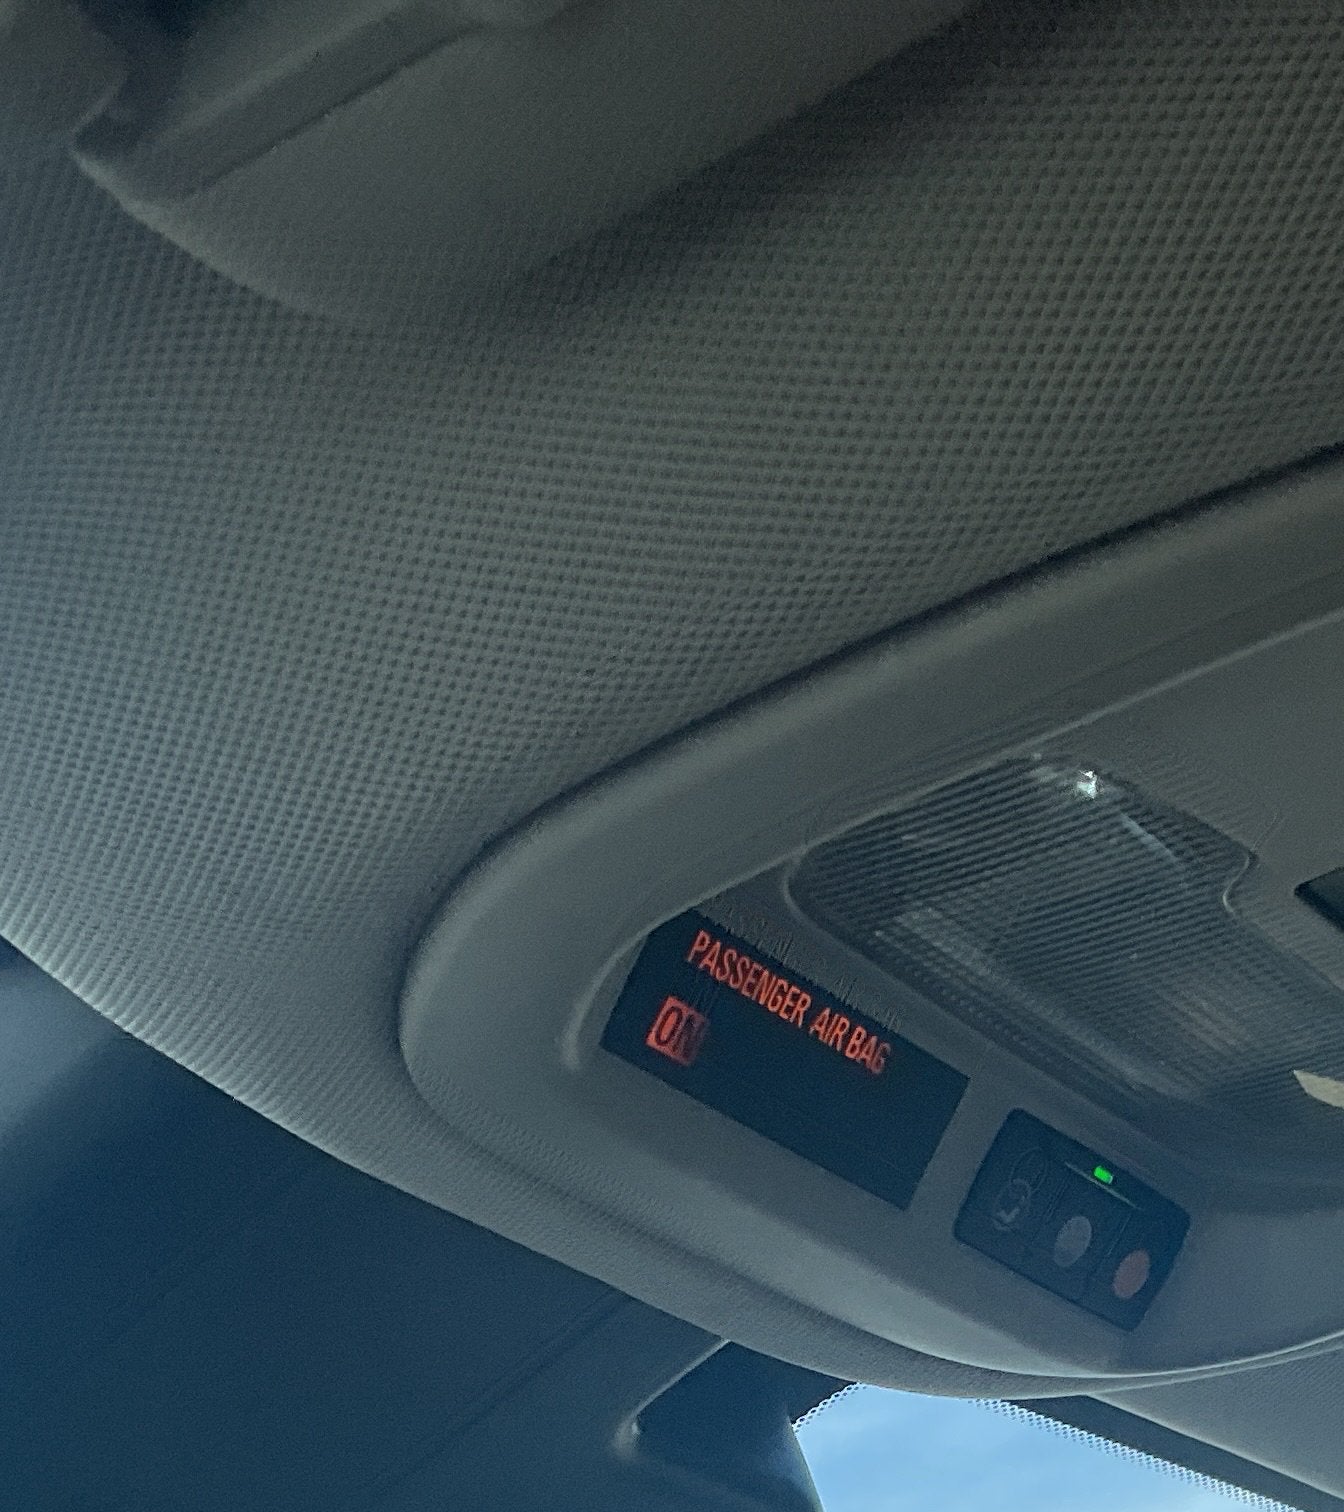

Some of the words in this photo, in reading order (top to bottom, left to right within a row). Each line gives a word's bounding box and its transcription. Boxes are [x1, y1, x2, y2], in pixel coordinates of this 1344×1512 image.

[654, 1004, 702, 1060] ON
[687, 929, 812, 1028] PASSENGER
[809, 1006, 851, 1051] AIR
[844, 1025, 892, 1075] BAG
